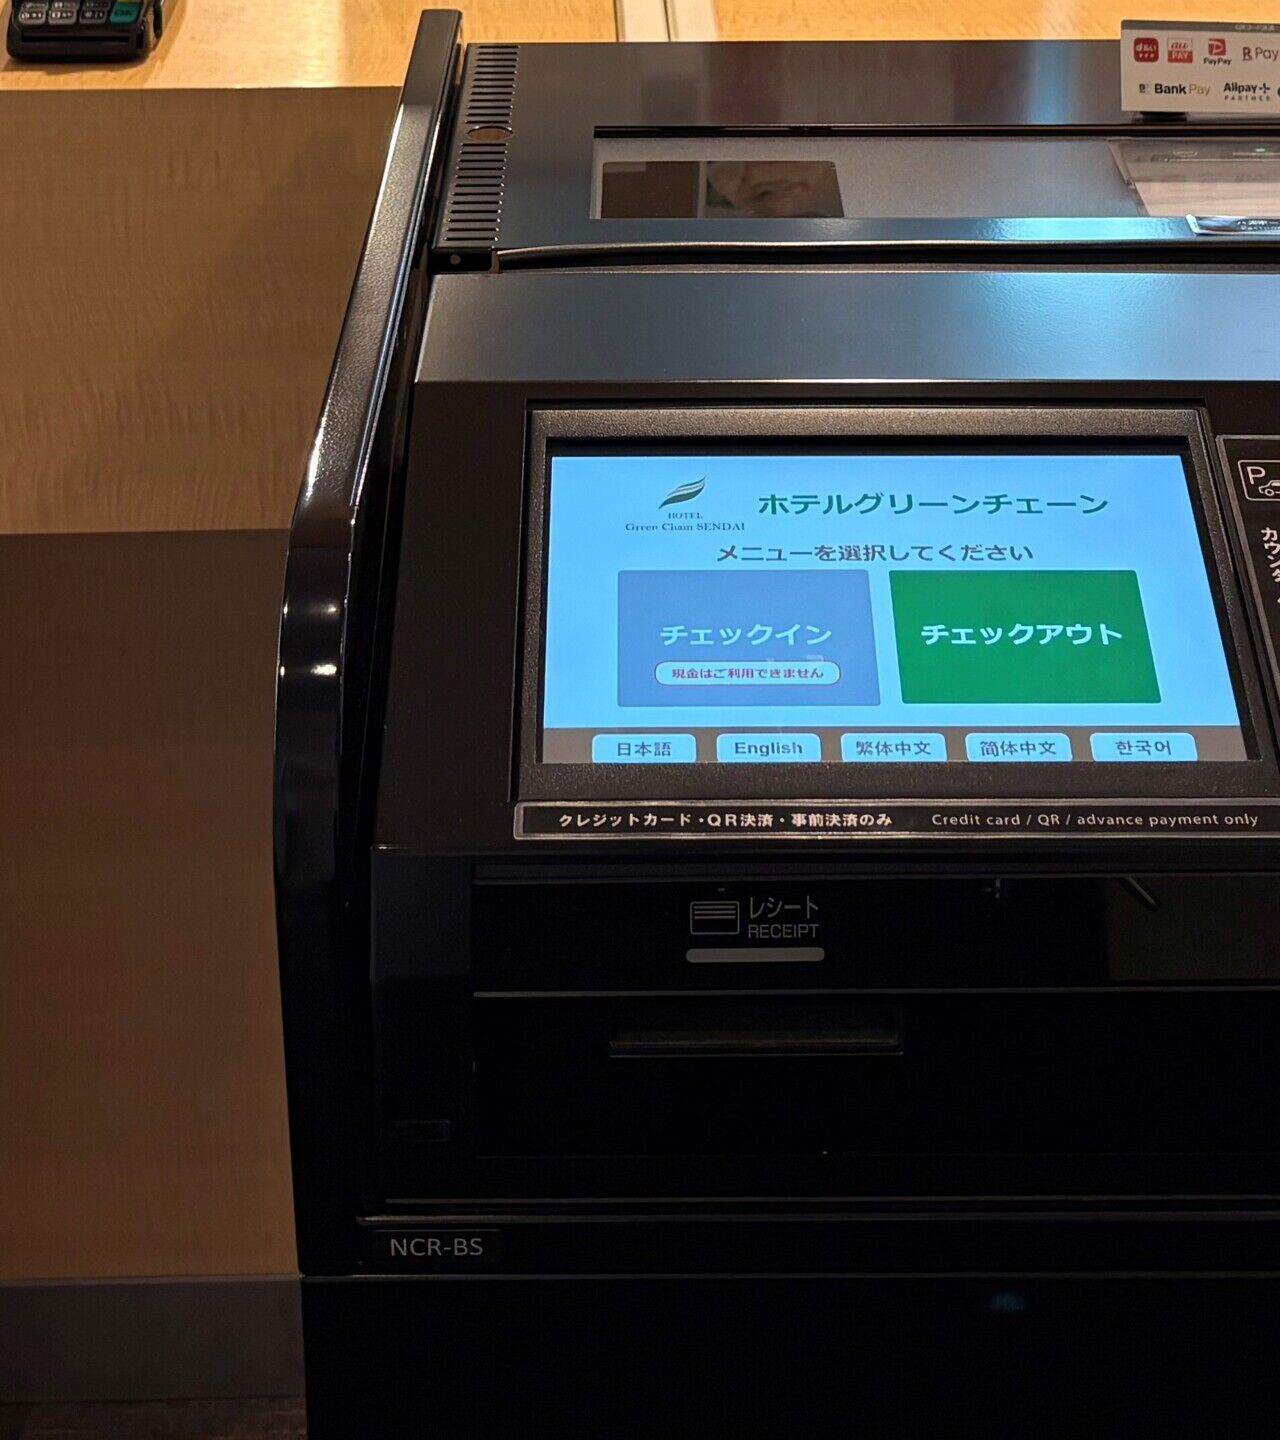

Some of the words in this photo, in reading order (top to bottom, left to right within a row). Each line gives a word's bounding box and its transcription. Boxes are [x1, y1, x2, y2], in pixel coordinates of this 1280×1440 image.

[1204, 56, 1232, 66] PayPay
[1154, 83, 1187, 95] Bank
[1189, 83, 1210, 96] Pay
[758, 493, 1109, 516] ホテルグリーンチェーン
[668, 512, 704, 520] HOTEL
[625, 522, 658, 532] Green
[661, 522, 694, 532] Chain
[696, 522, 745, 532] SENDAI
[718, 543, 1033, 562] メニューを選択してください
[660, 624, 832, 647] チェックイン
[921, 623, 1123, 647] チェックアウト
[672, 668, 824, 680] 現金はご利用できません
[617, 741, 671, 758] 日本語
[734, 741, 803, 757] English
[855, 740, 932, 758] 繁体中文
[980, 740, 1057, 758] 简体中文
[1114, 739, 1172, 757] 한국어
[559, 813, 892, 828] クレジットカード・QR決済・事前決済のみ
[932, 814, 981, 826] Credit
[986, 814, 1020, 826] card
[1038, 814, 1060, 827] QR
[1077, 814, 1143, 826] advance
[1149, 814, 1219, 828] payment
[1224, 813, 1259, 828] only
[749, 895, 819, 919] レシート
[748, 924, 820, 939] RECEIPT
[390, 1238, 484, 1257] NCR-BS
